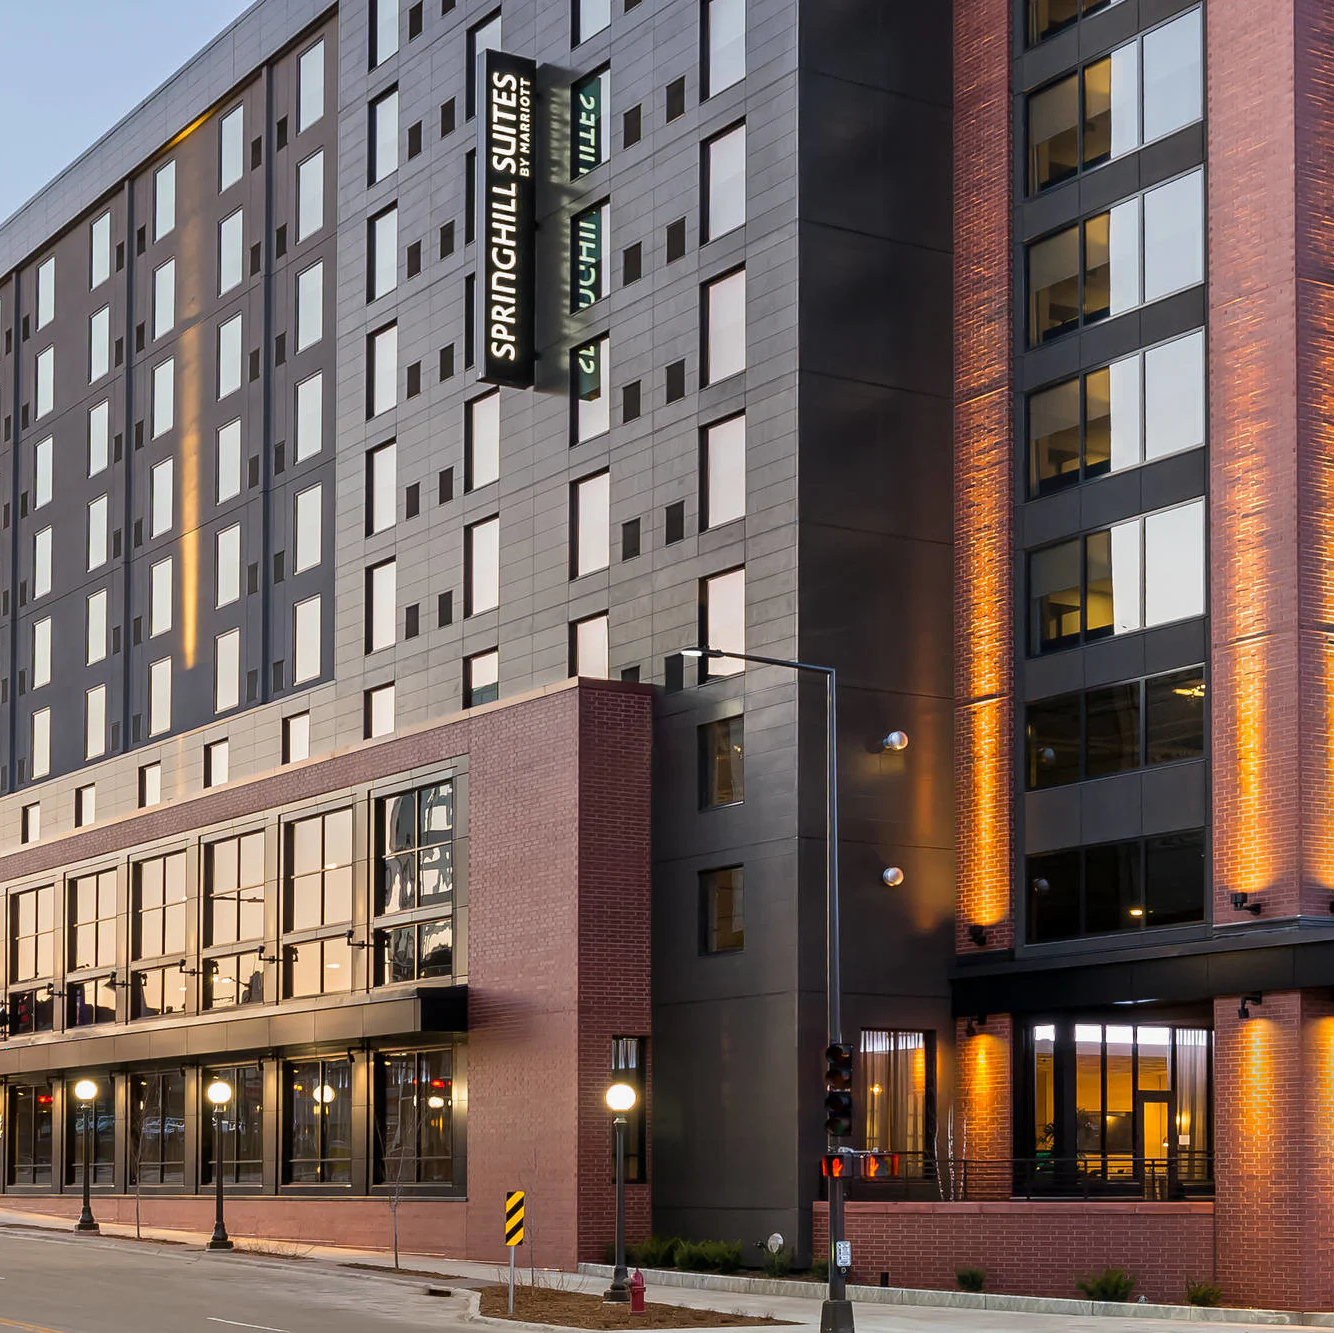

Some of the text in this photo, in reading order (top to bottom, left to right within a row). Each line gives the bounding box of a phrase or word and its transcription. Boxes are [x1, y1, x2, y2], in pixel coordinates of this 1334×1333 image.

[491, 71, 517, 362] SPRINGHILL SUITES
[519, 77, 531, 177] BY MARRIOTT
